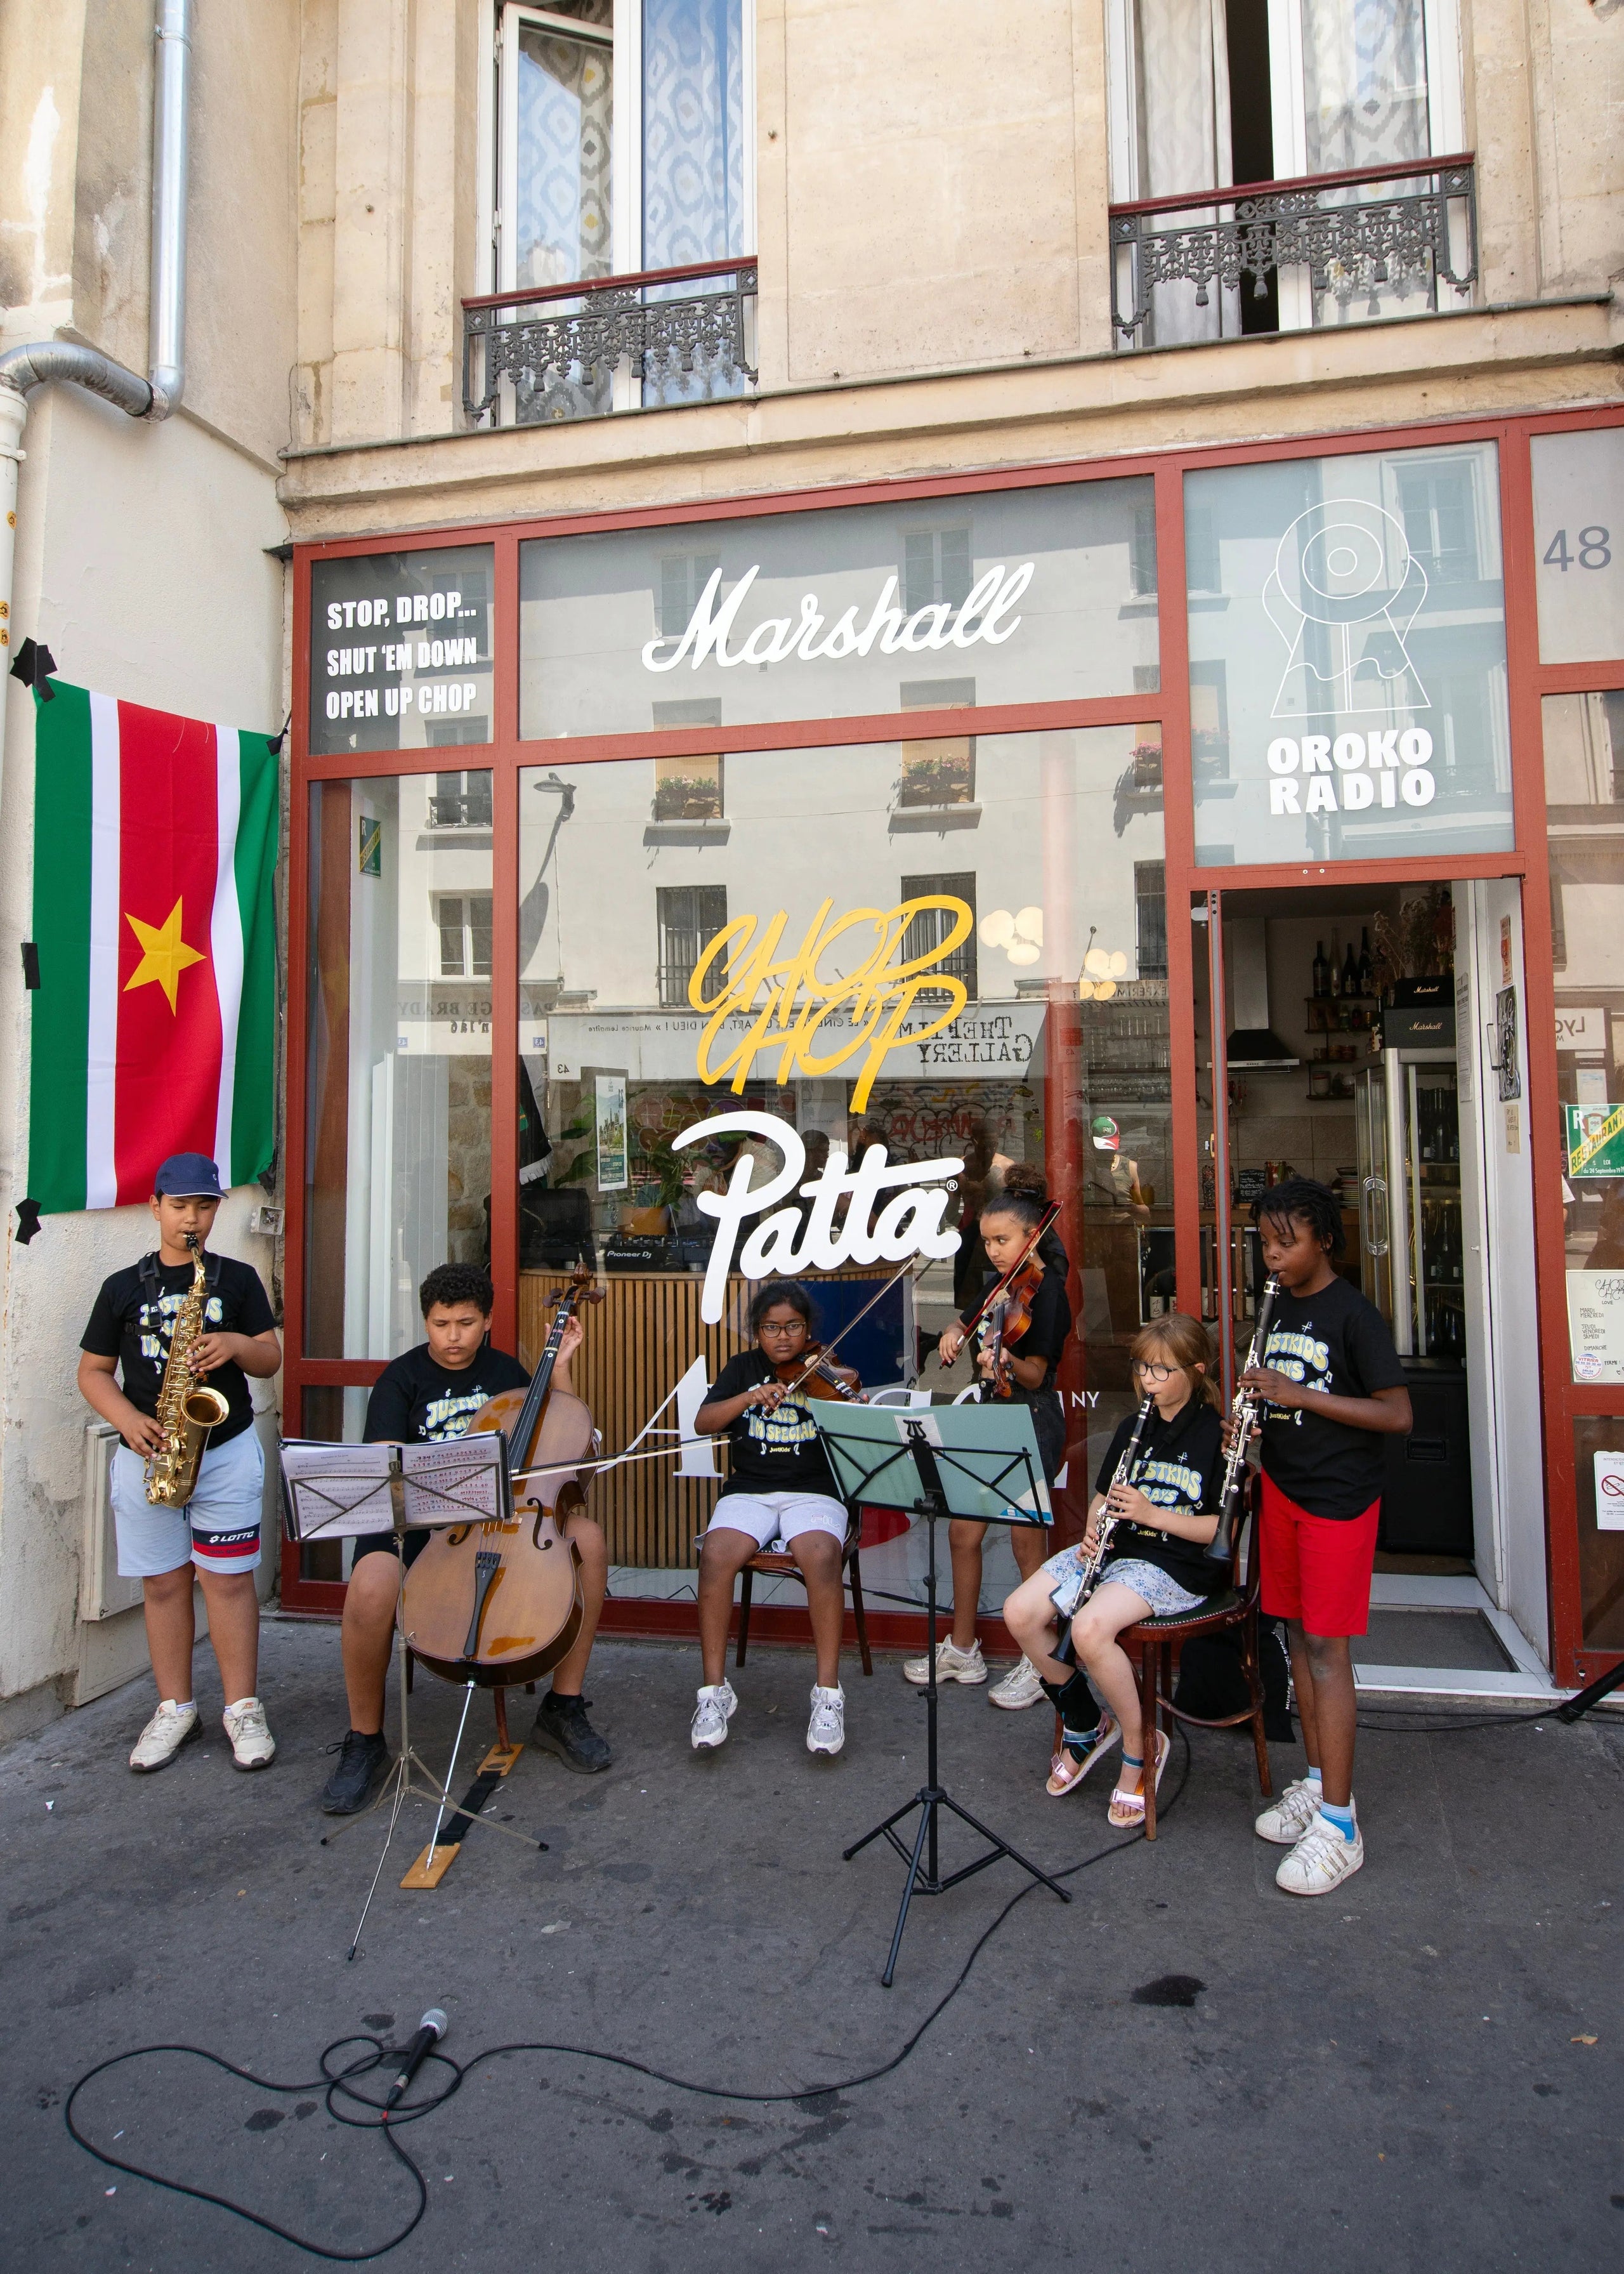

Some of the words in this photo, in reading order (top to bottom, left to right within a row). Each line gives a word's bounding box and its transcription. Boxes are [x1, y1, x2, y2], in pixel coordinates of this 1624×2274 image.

[1543, 526, 1612, 572] 48
[327, 599, 389, 629] STOP,
[641, 562, 1035, 672] Marshall
[327, 646, 377, 677] SHUT
[417, 637, 476, 668] DOWN
[326, 689, 378, 719] OPEN
[385, 687, 413, 716] UP
[418, 683, 476, 714] CHOP
[1267, 728, 1433, 774] OROKO
[1269, 769, 1436, 815] RADIO
[688, 895, 973, 1028] CHOP
[1413, 985, 1440, 994] Marshall
[697, 974, 967, 1114] CHOP
[1409, 1022, 1443, 1030] Marshall
[1573, 1110, 1585, 1129] R
[671, 1110, 965, 1325] Patta
[1071, 1391, 1099, 1408] NY
[749, 1414, 765, 1440] I'M
[766, 1419, 817, 1443] SPECIAL
[220, 1531, 255, 1542] LOTTO
